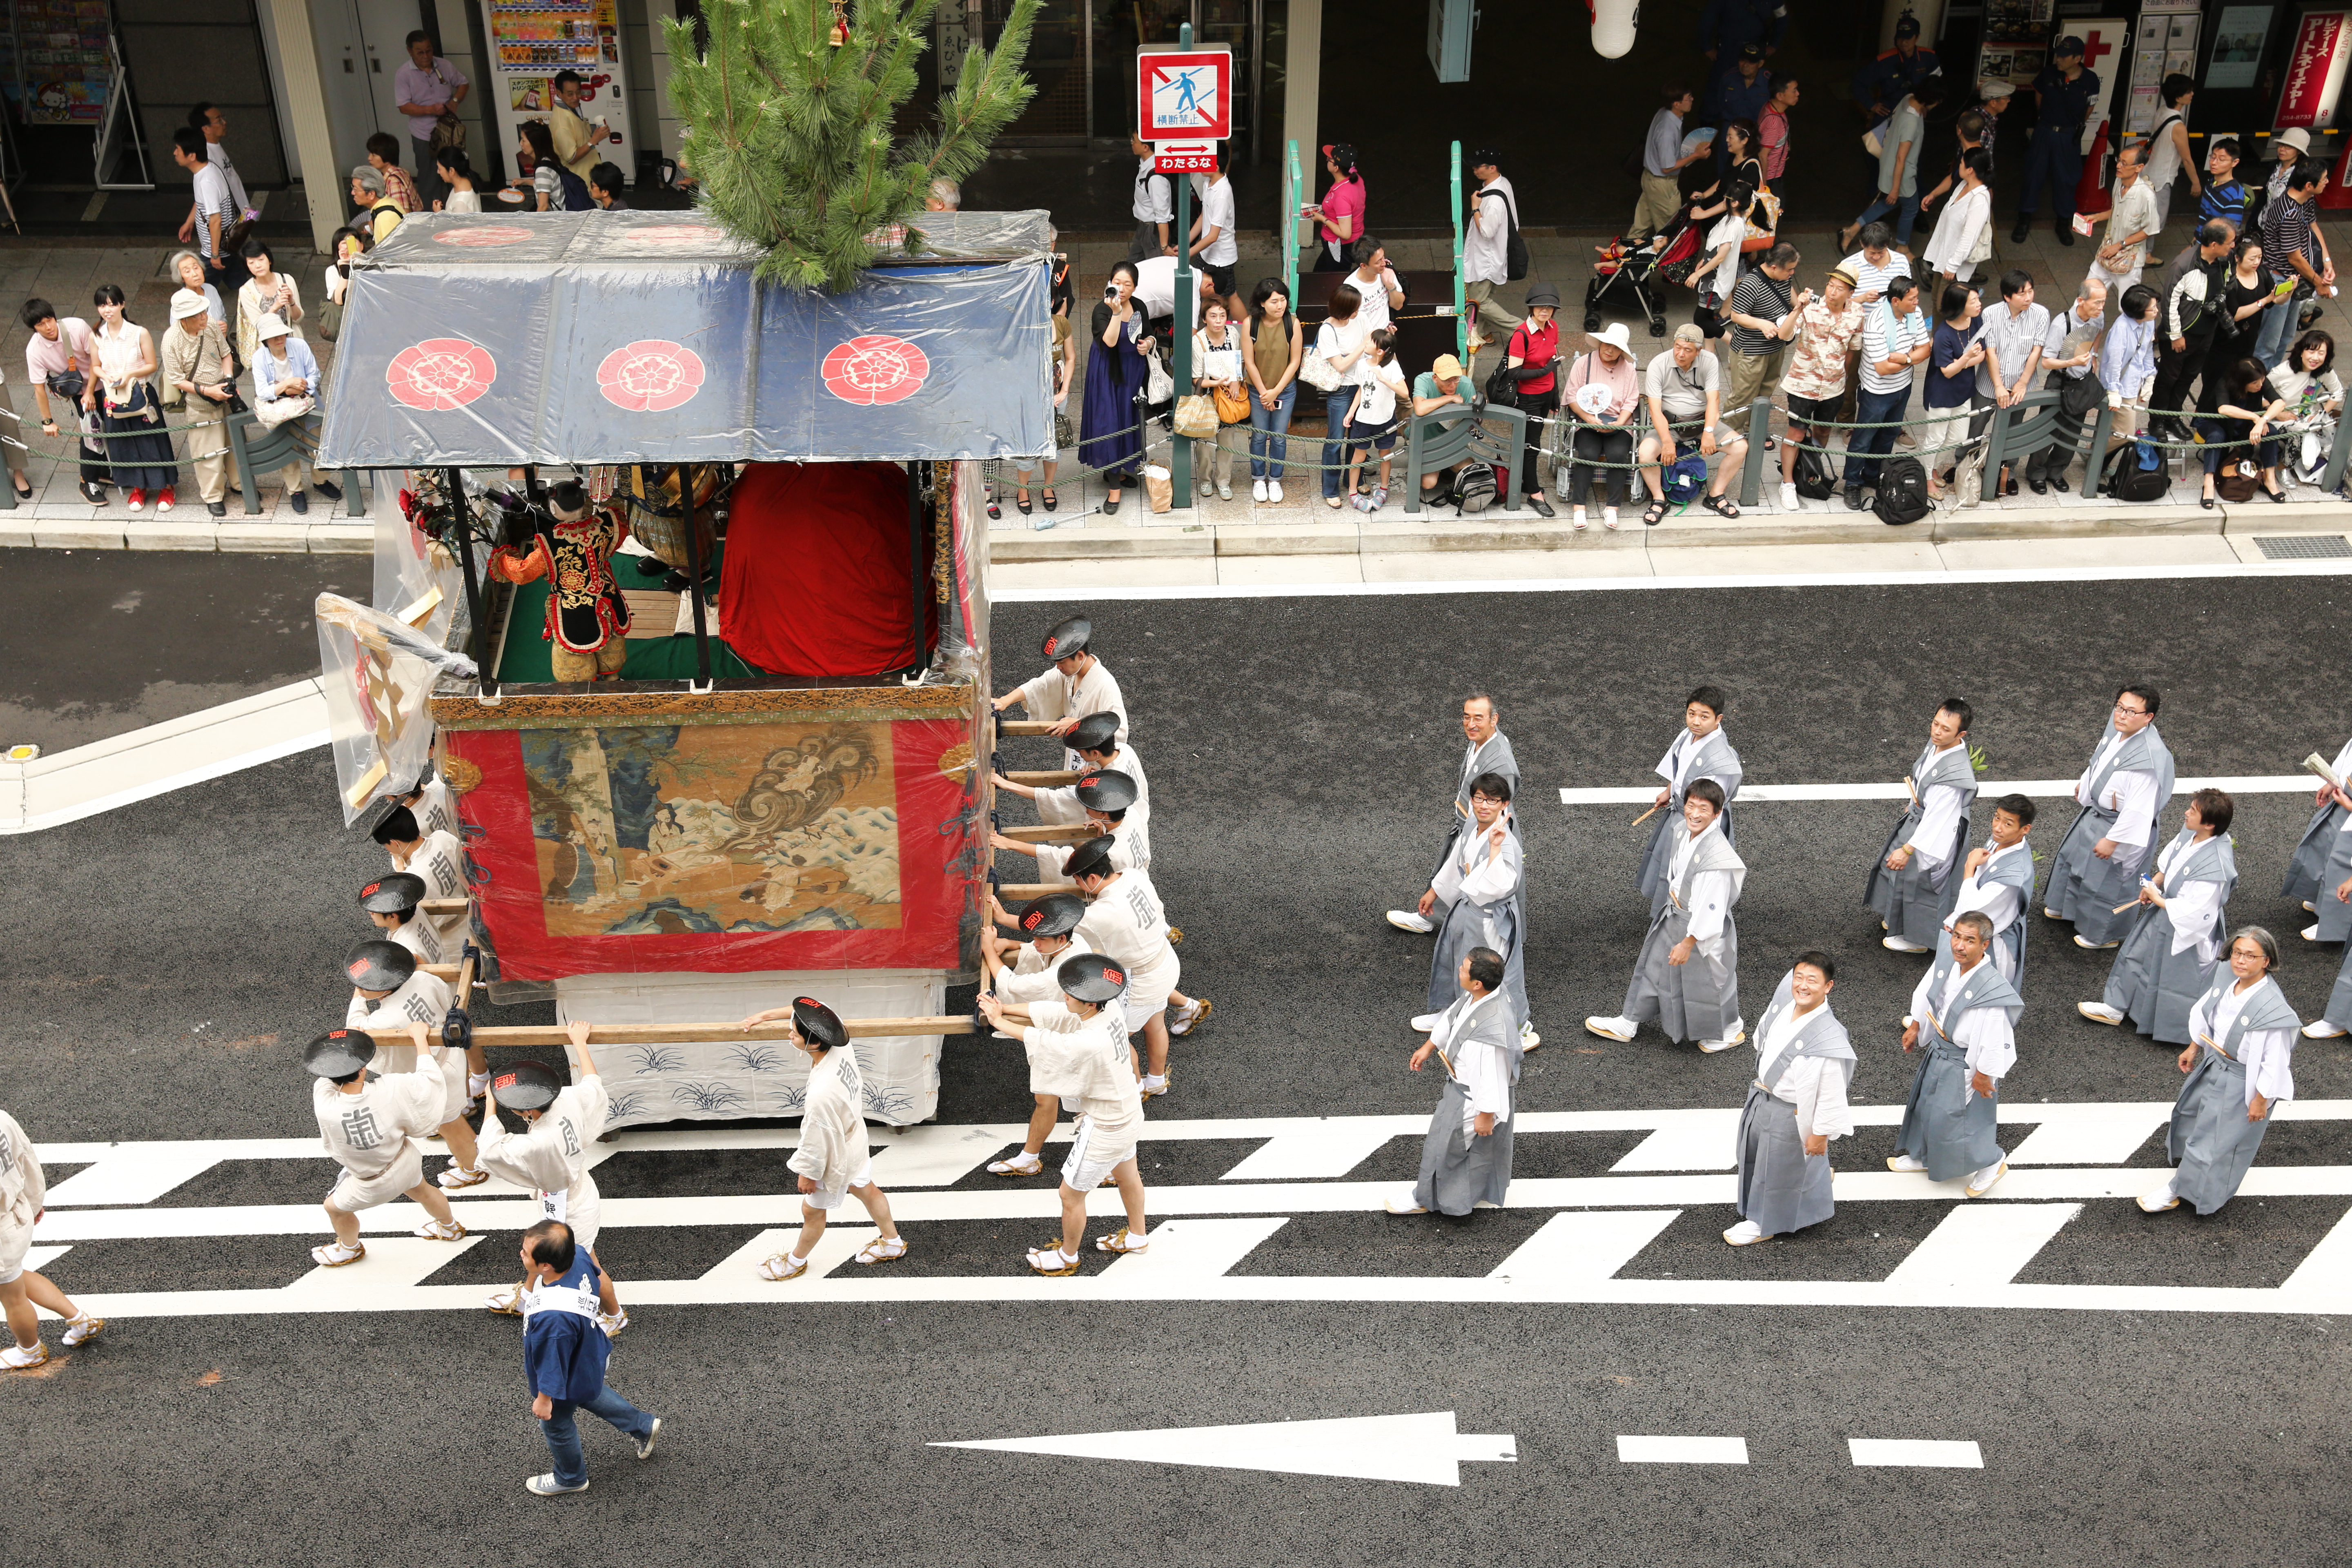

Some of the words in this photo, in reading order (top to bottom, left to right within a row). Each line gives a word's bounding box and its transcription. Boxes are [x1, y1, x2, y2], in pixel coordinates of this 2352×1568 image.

[2316, 18, 2337, 58] レディース
[2289, 18, 2323, 109] アートネイチャー
[1157, 114, 1199, 125] 横断禁止
[1161, 157, 1212, 169] わたるな
[1187, 415, 1215, 423] Afternoon
